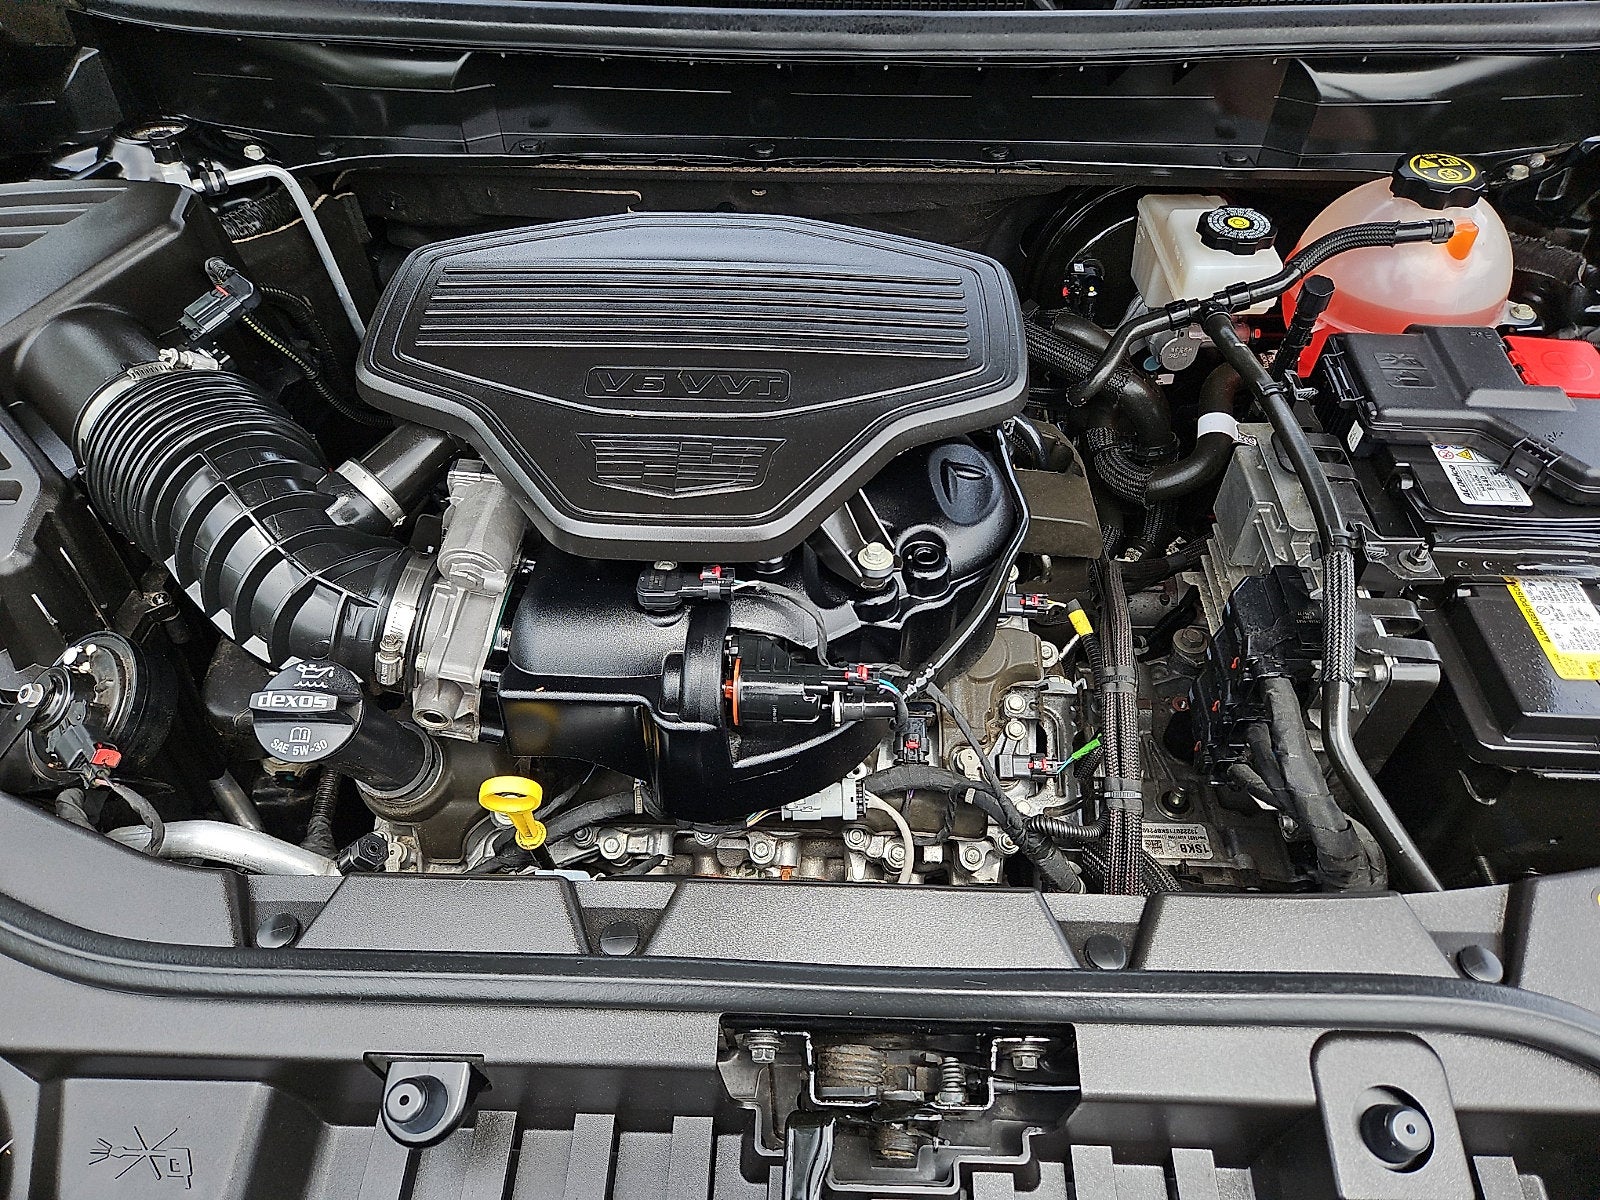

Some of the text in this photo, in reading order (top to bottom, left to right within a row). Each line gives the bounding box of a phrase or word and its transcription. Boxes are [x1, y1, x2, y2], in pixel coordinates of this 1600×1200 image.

[597, 373, 782, 395] V6 VVT
[1448, 464, 1473, 499] ACDelco
[257, 691, 328, 708] dexos
[270, 739, 328, 756] SAE 5W-30
[1179, 843, 1210, 854] 1SKB
